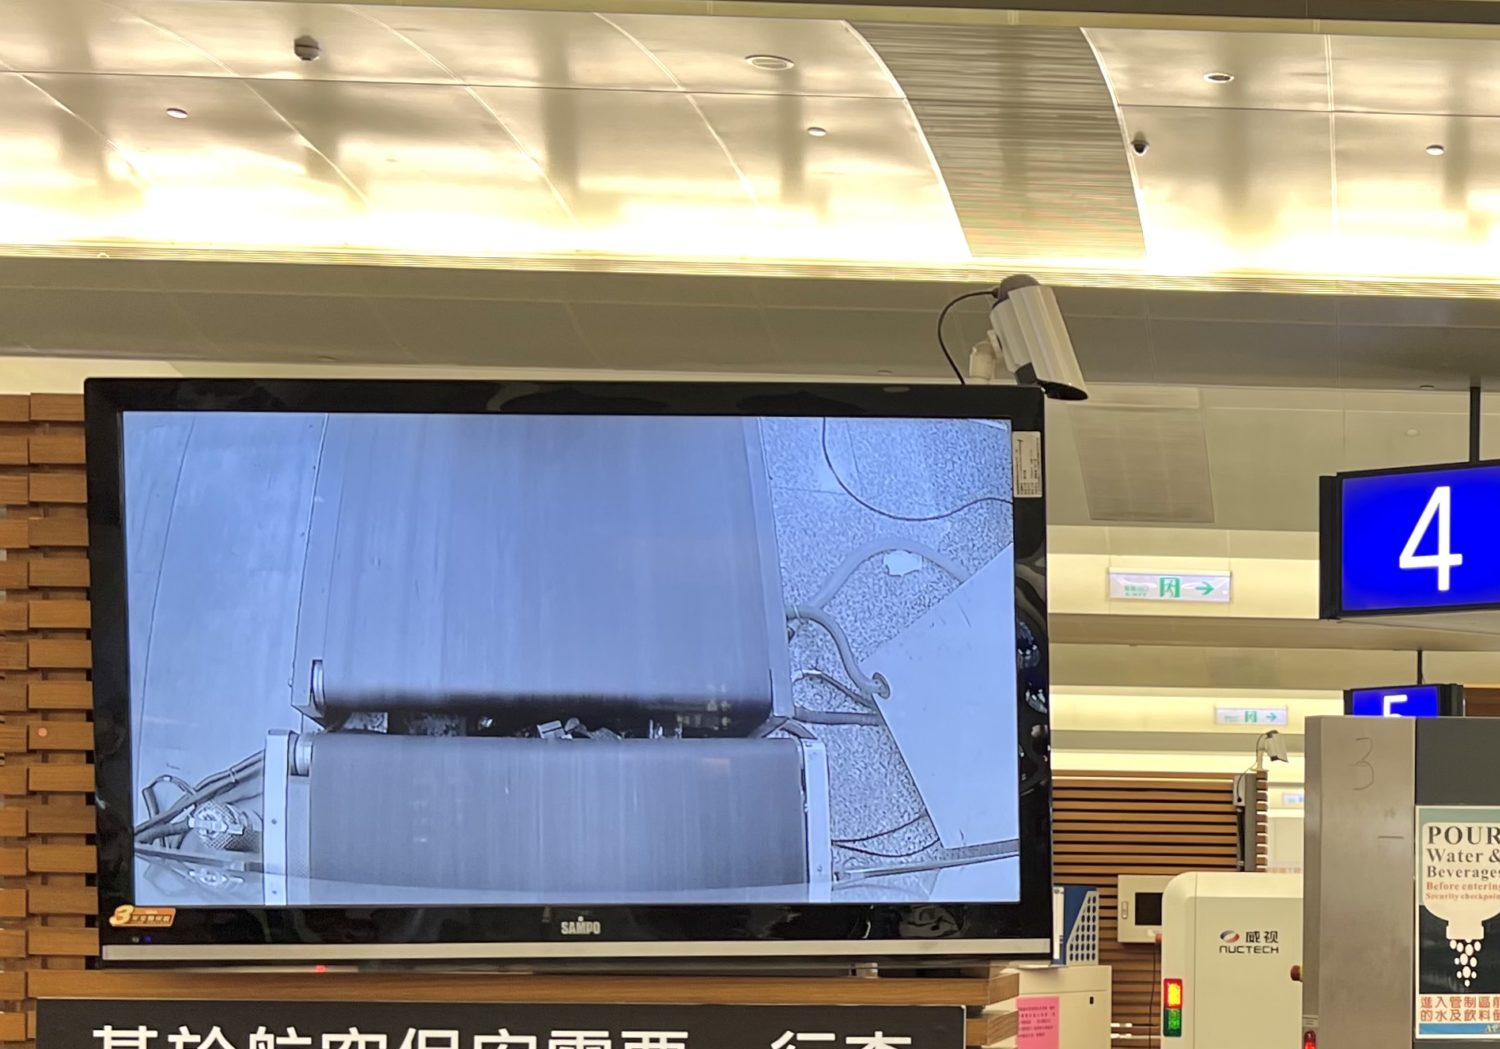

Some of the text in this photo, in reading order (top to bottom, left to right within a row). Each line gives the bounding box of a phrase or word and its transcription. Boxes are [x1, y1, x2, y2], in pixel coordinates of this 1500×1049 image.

[1399, 486, 1463, 591] 4
[1348, 736, 1375, 791] 3
[1426, 848, 1484, 863] Water
[1426, 881, 1460, 891] Before
[1426, 892, 1459, 900] Security
[561, 917, 601, 935] SAMPO
[1246, 930, 1279, 943] 威视
[1219, 945, 1279, 954] NUCTECH
